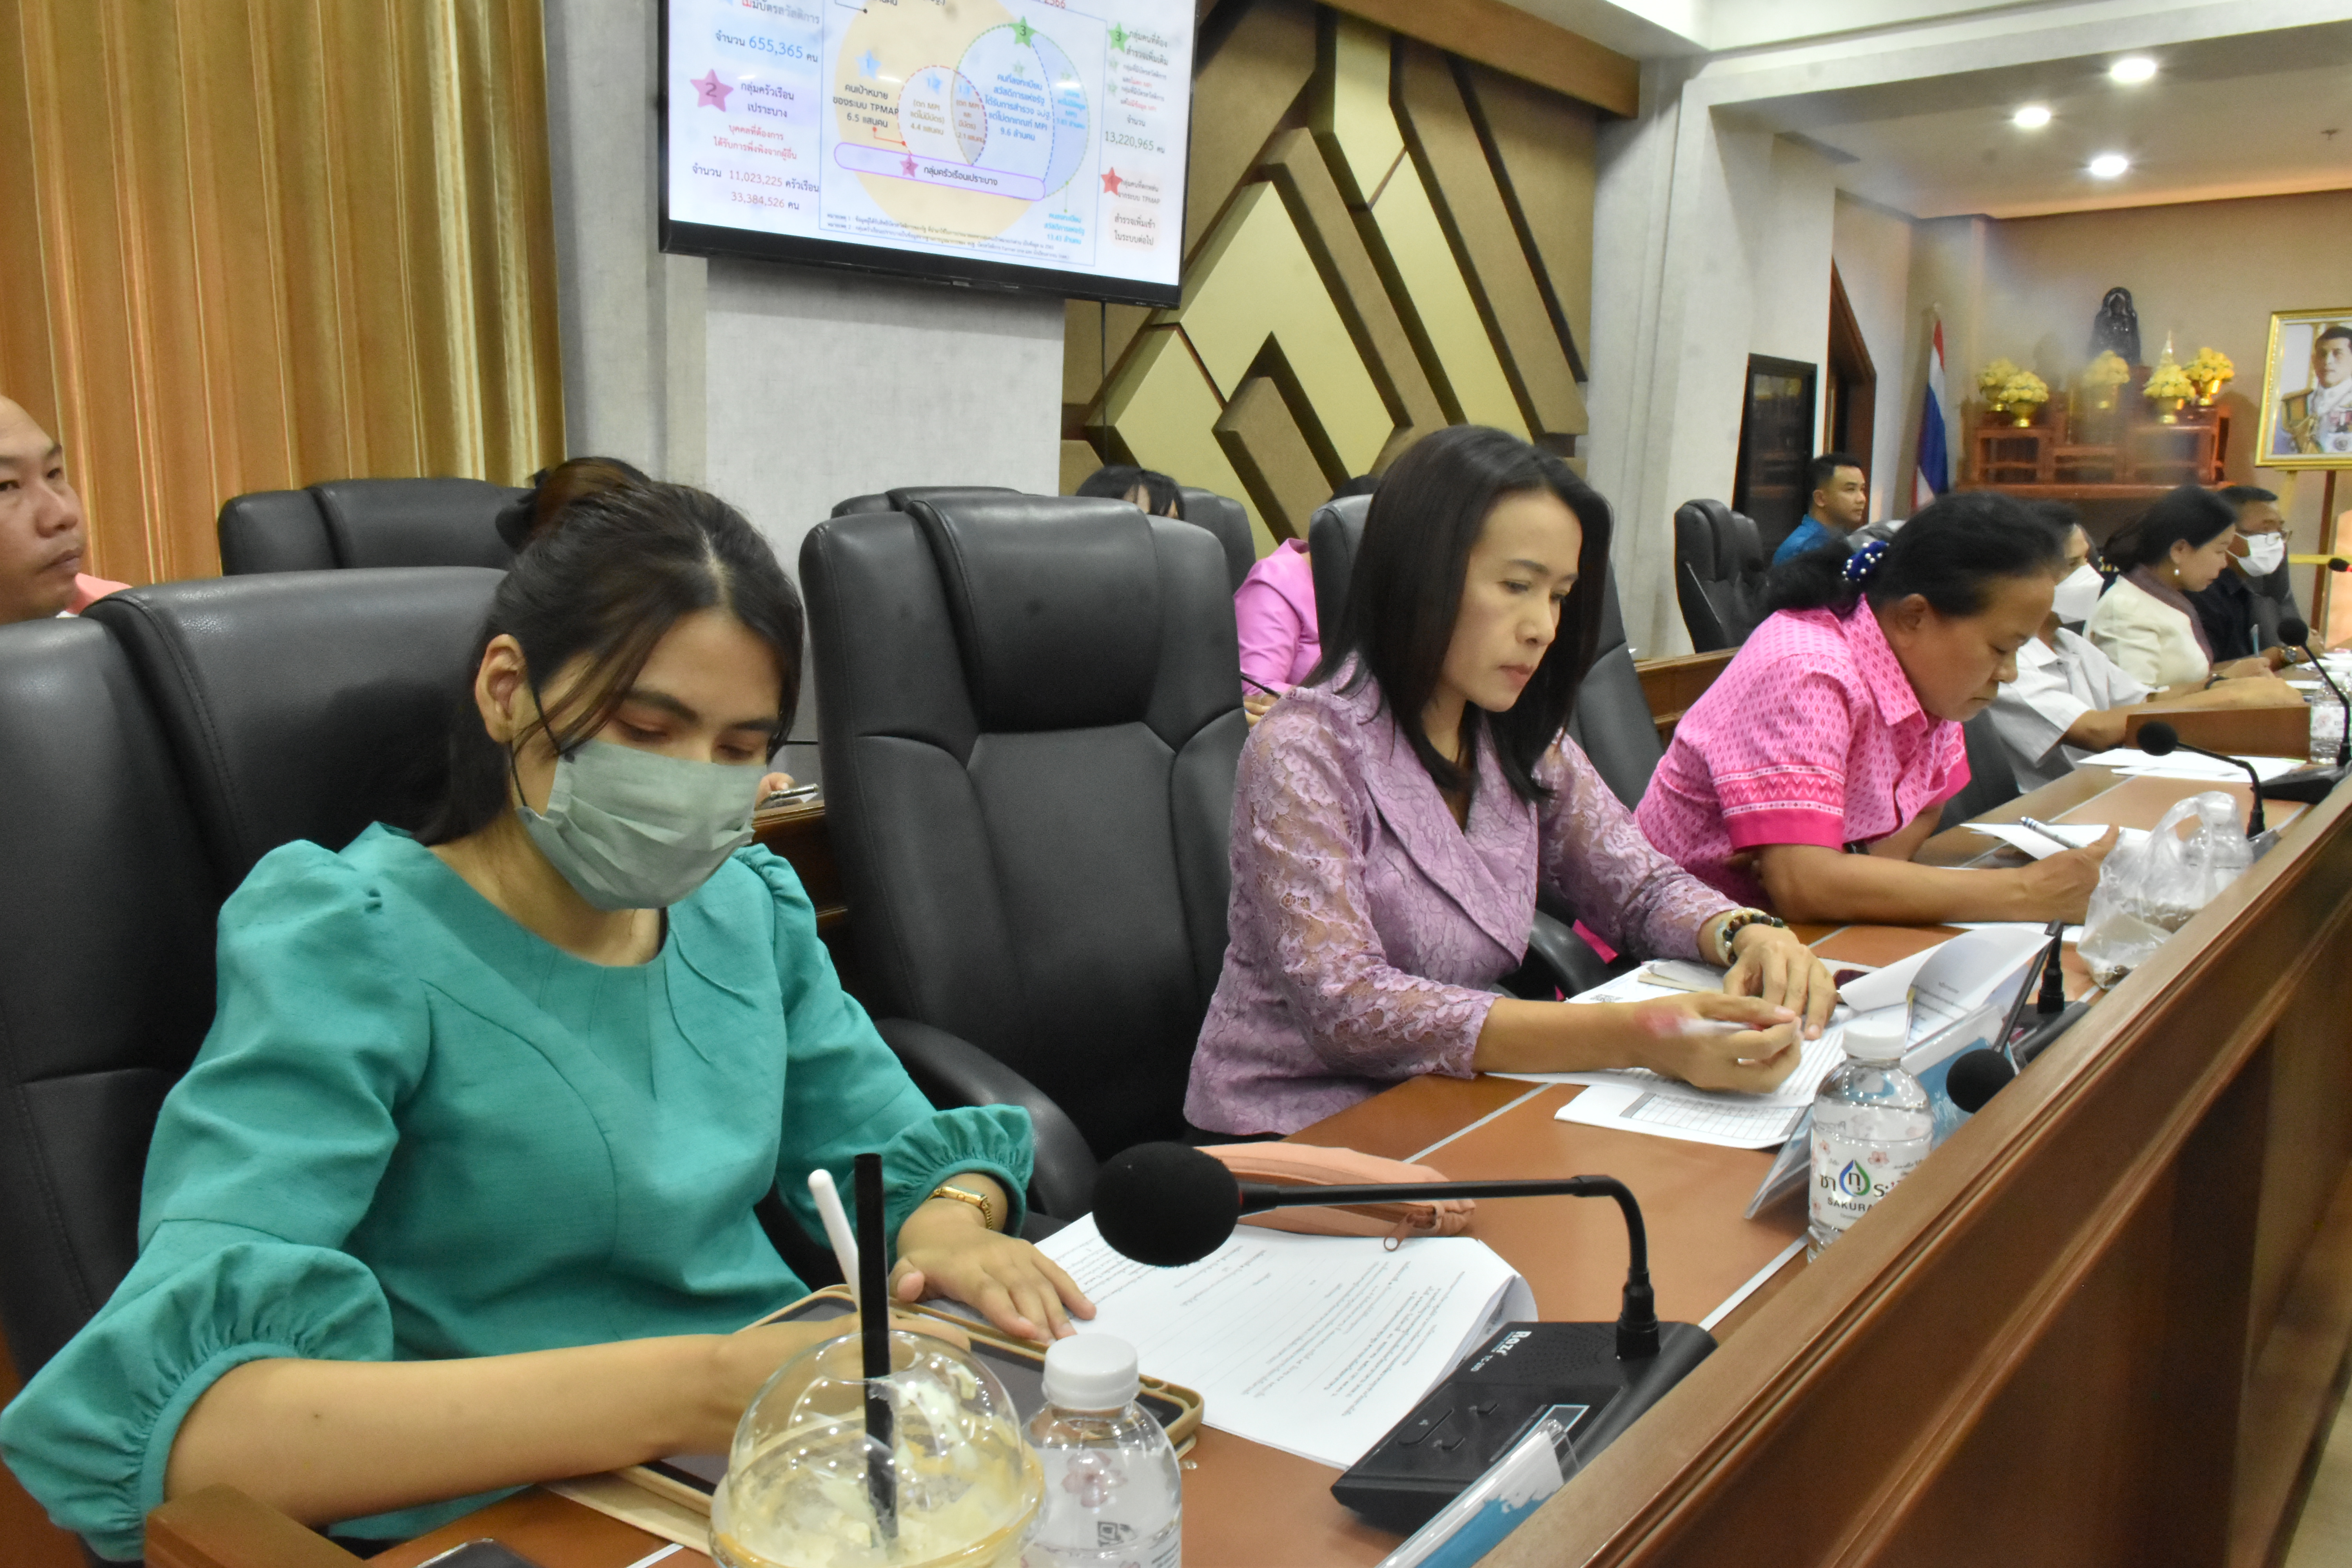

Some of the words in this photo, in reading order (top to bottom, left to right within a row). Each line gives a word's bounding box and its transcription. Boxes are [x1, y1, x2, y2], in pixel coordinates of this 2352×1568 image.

[1020, 25, 1026, 36] 3
[1116, 31, 1122, 42] 3
[715, 29, 745, 46] จำนวน
[749, 36, 803, 59] 655,365
[806, 53, 818, 63] คน
[705, 82, 717, 98] 2
[741, 82, 795, 101] กลุ่มครัวเรือน
[845, 84, 888, 99] คนเป้าหมาย
[748, 102, 788, 118] เปราะบาง
[833, 96, 867, 110] ของระบบ
[870, 103, 899, 116] TPMAP
[847, 113, 860, 122] 6.5
[862, 116, 888, 127] แสนคน
[1034, 122, 1047, 131] MPI
[1127, 114, 1146, 127] จำนวน
[1105, 131, 1154, 151] 13,220,965
[693, 162, 721, 178] จำนวน
[730, 170, 782, 187] 11,023,225
[785, 178, 819, 192] ครัวเรือน
[924, 165, 998, 186] กลุ่มครัวเรือนเปราะบาง
[731, 191, 785, 209] 33,384,526
[788, 201, 799, 210] คน
